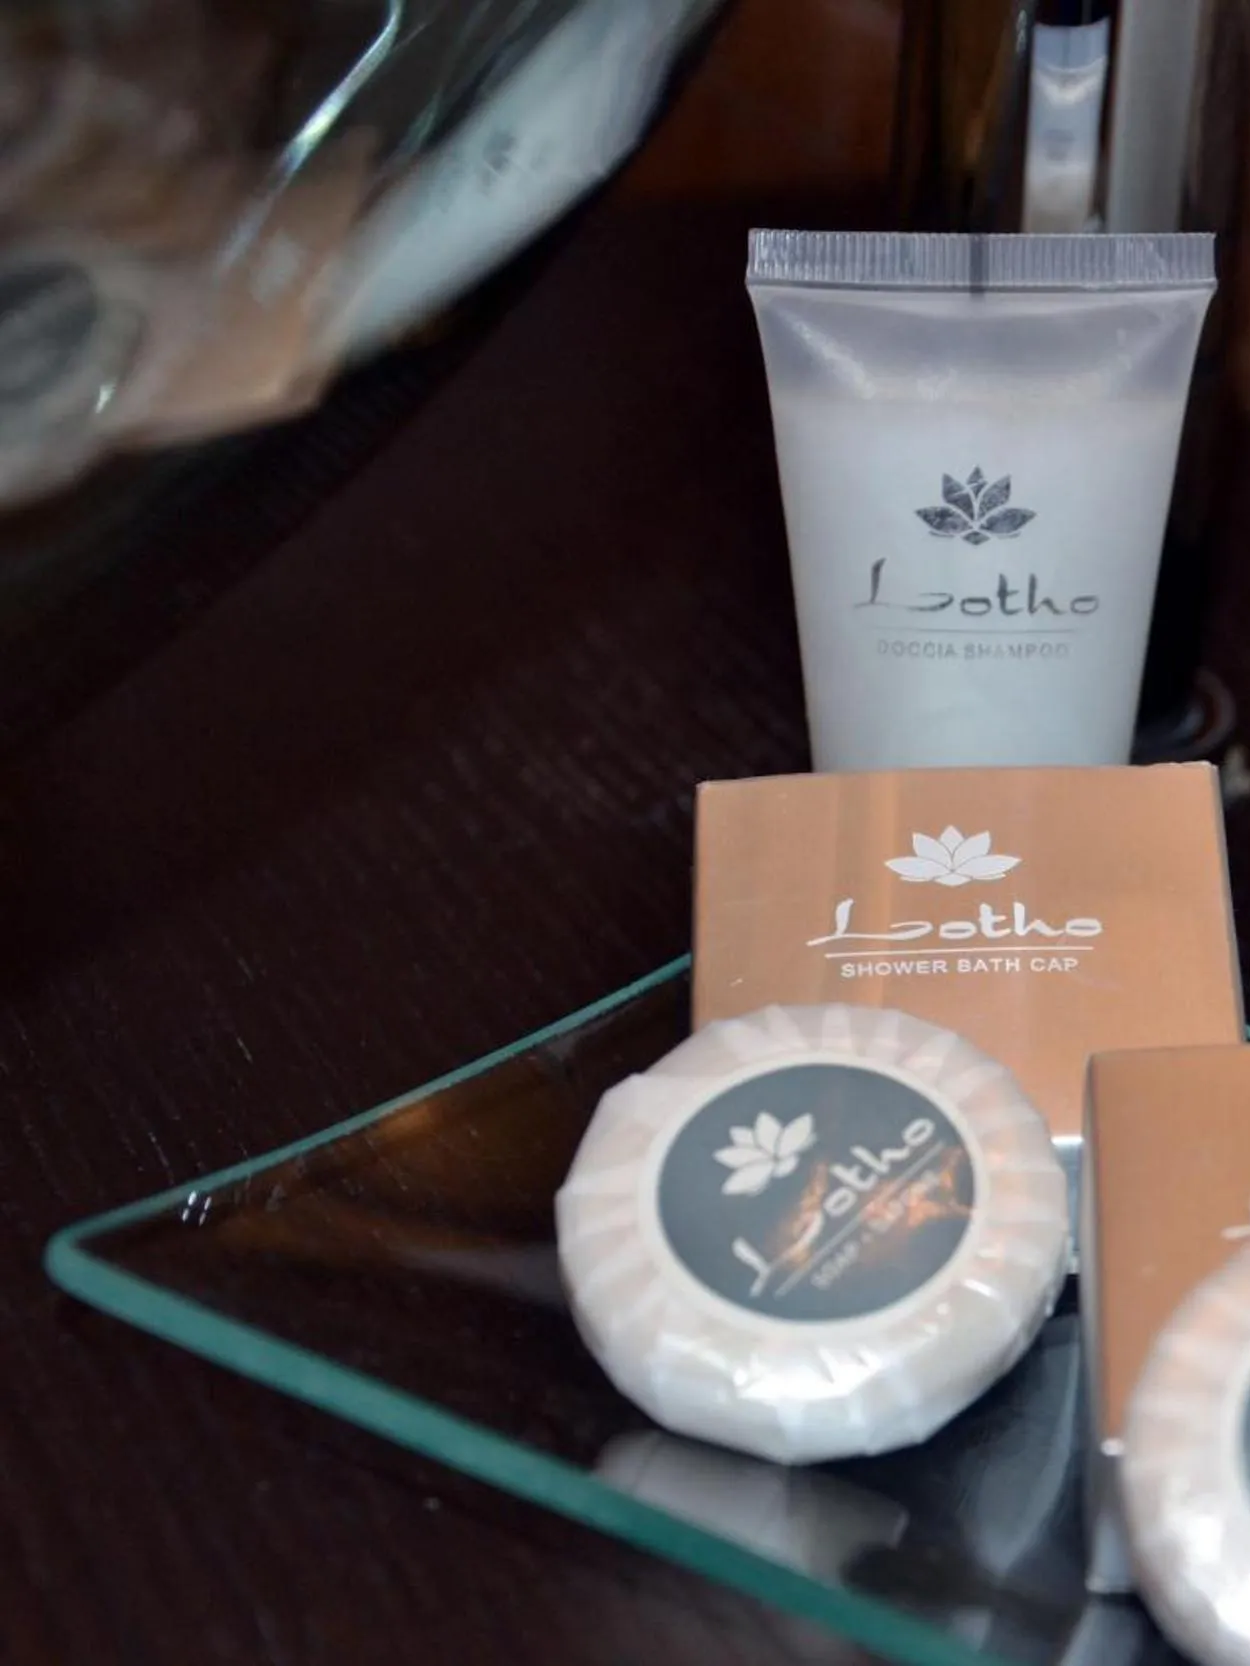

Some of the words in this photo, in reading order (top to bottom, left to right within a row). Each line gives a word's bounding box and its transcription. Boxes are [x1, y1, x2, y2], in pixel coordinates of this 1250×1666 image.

[852, 557, 1100, 616] Lotho
[877, 639, 955, 660] DOCCIA
[963, 641, 1070, 662] SHAMPOO
[806, 898, 1103, 947] Lotho
[840, 959, 948, 979] SHOWER
[957, 956, 1022, 974] BATH
[1030, 956, 1079, 973] CAP
